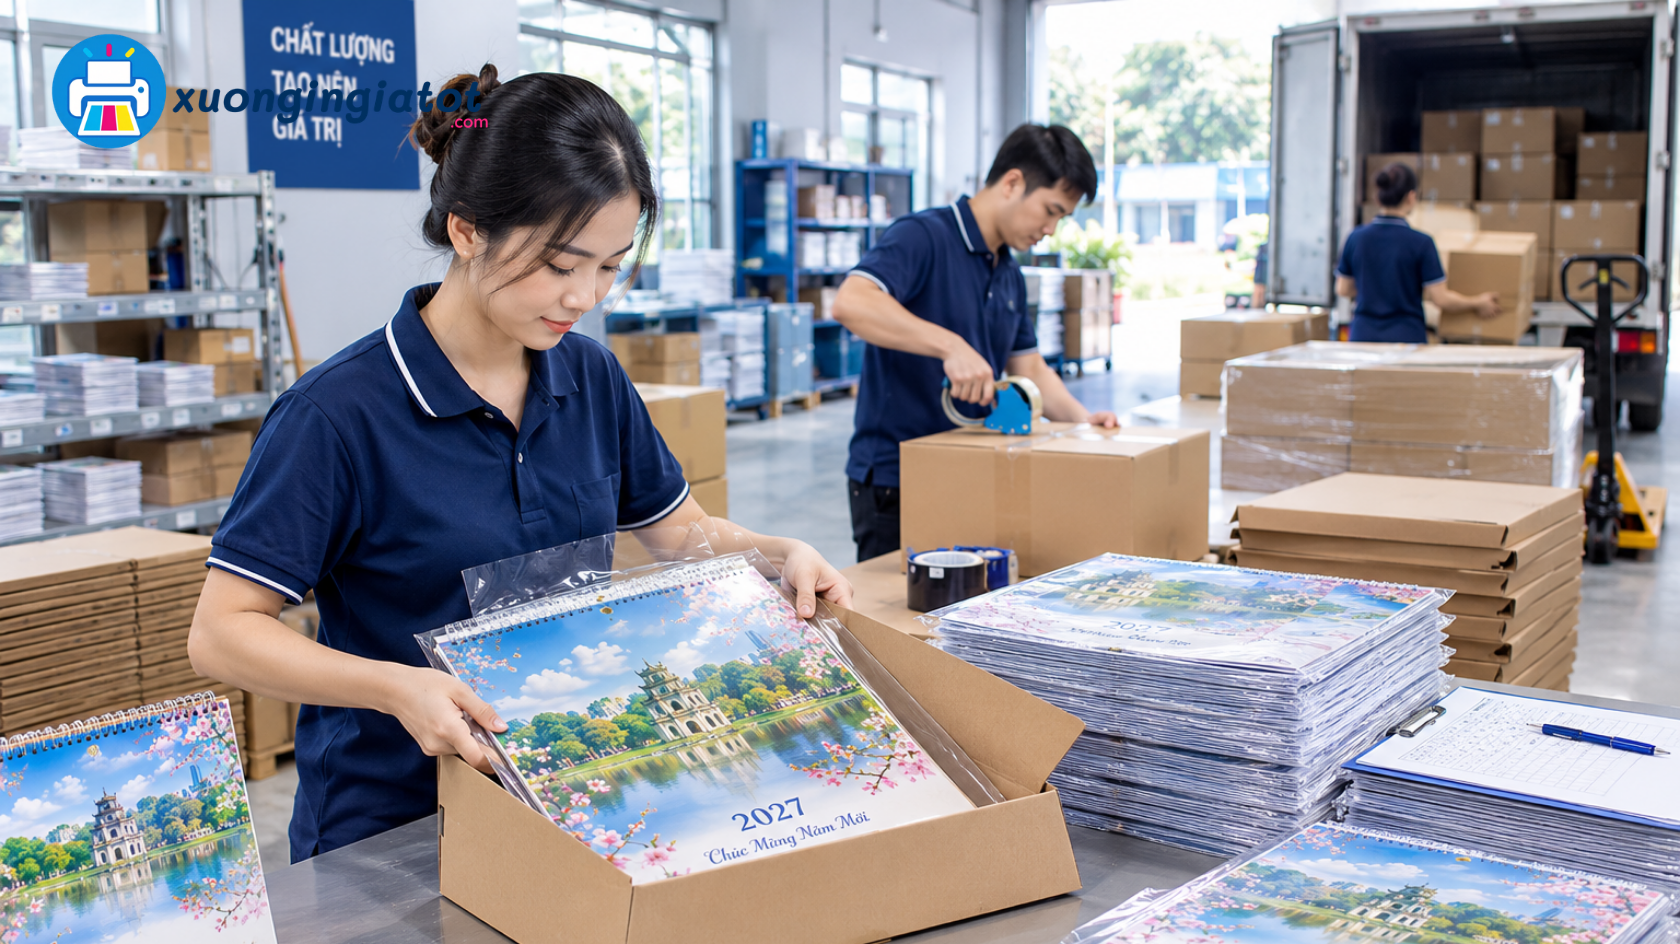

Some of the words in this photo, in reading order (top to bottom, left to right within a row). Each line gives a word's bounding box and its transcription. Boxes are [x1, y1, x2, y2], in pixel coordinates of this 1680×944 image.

[270, 21, 325, 56] CHẤT
[329, 32, 395, 66] LƯỢNG
[311, 115, 342, 148] TRỊ
[731, 796, 805, 832] 2027
